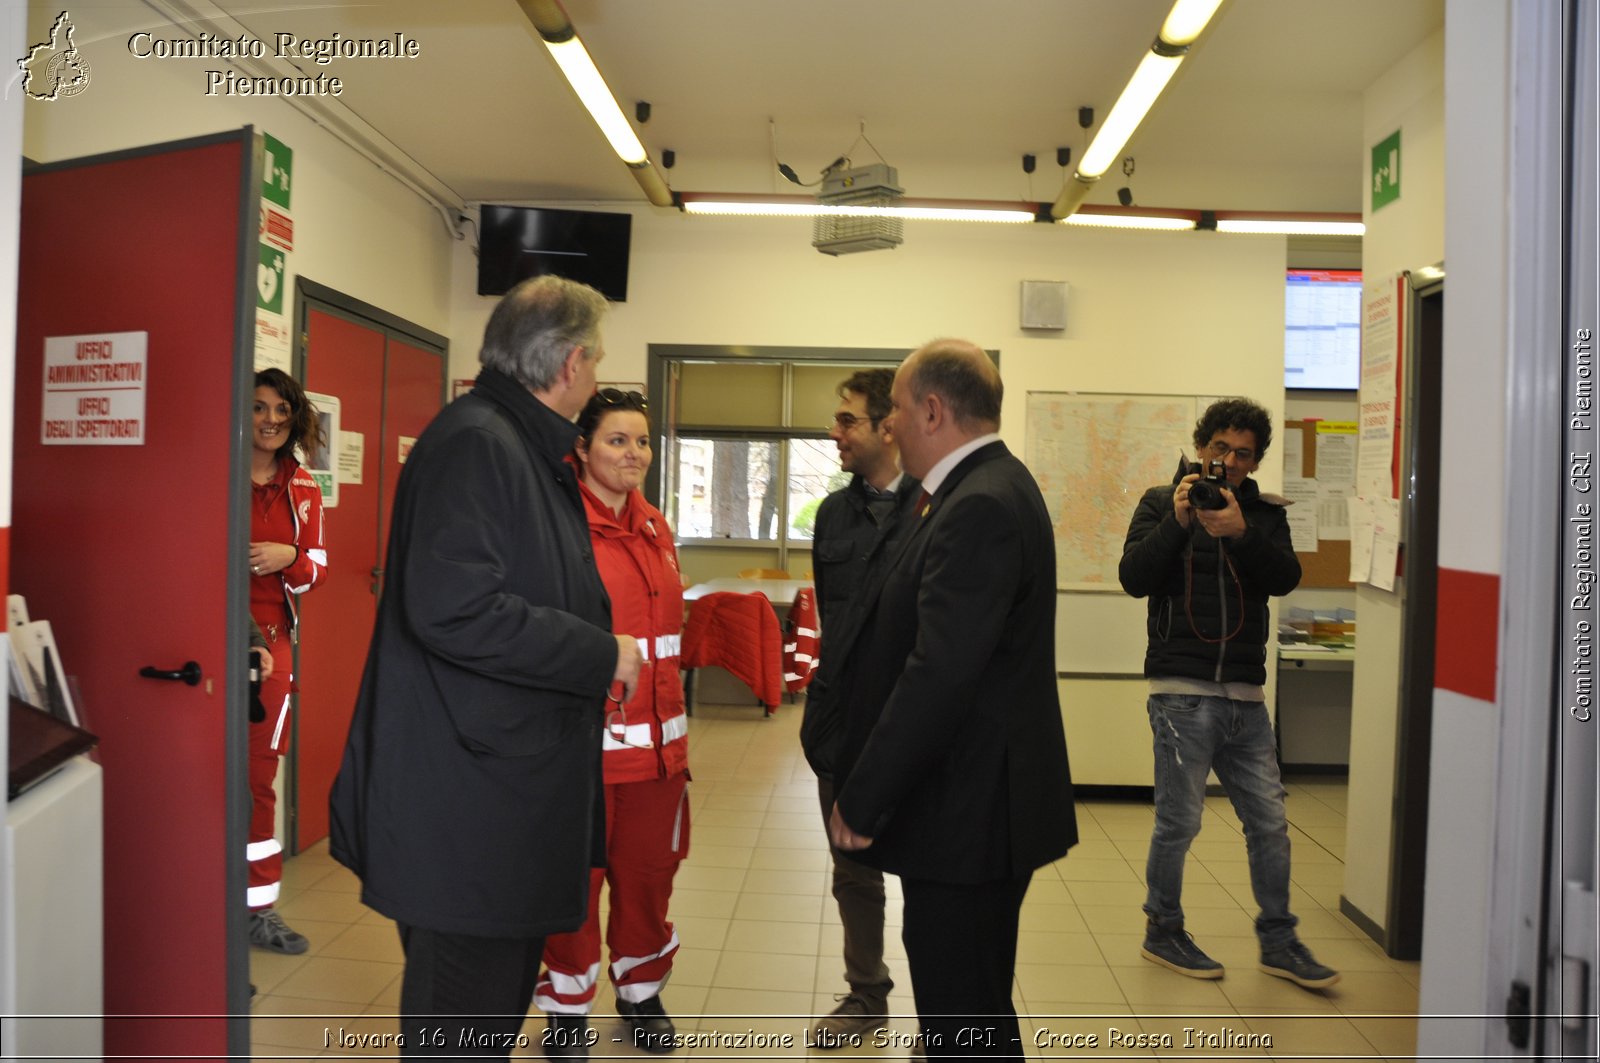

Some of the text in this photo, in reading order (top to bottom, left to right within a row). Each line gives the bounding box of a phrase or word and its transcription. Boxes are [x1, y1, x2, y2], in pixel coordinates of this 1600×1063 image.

[76, 341, 112, 360] UFFICI
[48, 362, 142, 383] AMMINISTRATIVI
[78, 397, 110, 416] UFFICI
[45, 419, 139, 438] DEGLI ISPETTORATI
